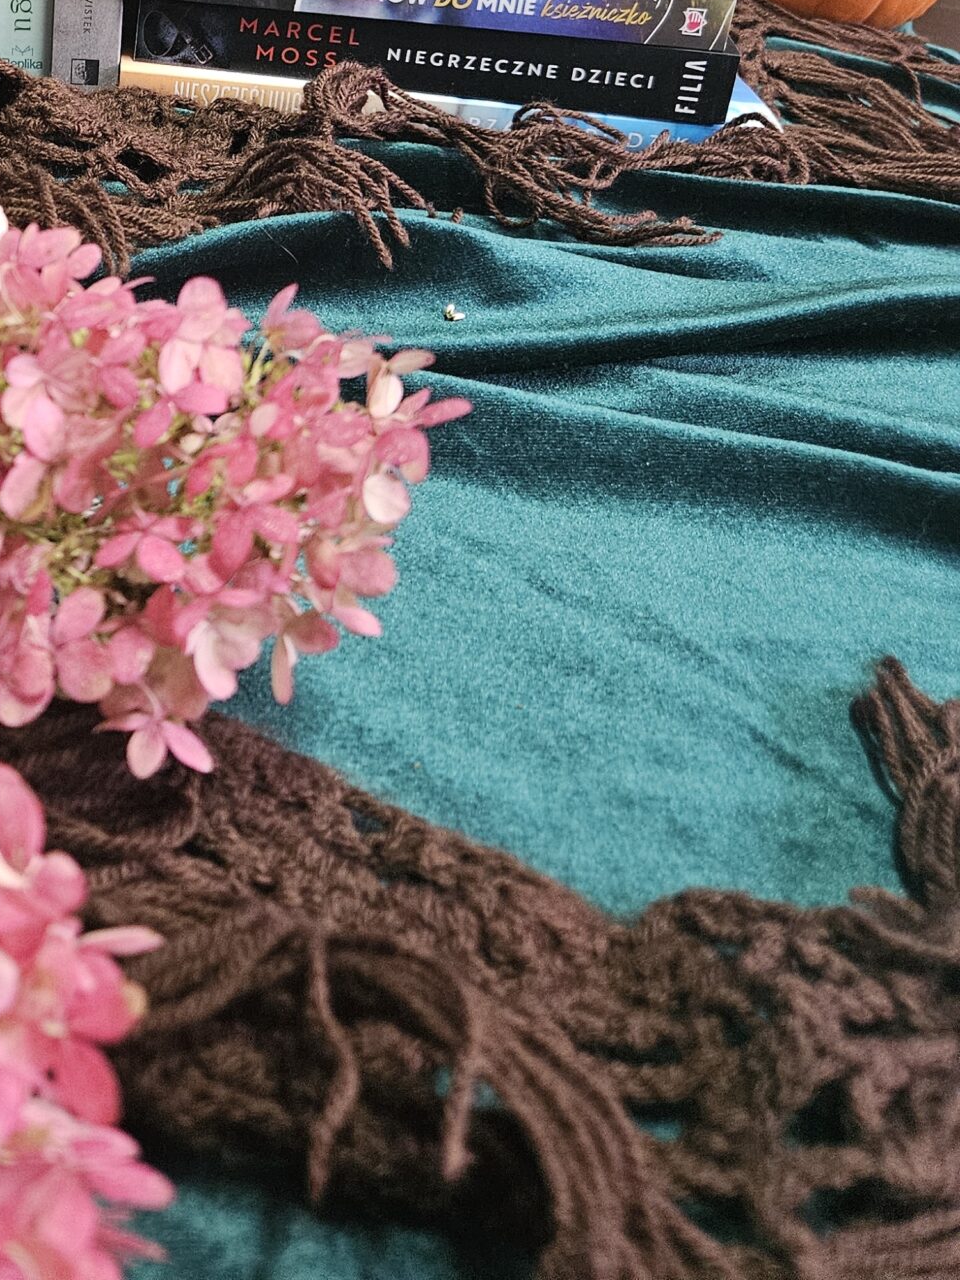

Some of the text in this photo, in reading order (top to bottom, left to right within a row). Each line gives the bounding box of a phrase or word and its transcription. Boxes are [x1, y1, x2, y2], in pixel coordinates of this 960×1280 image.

[239, 16, 360, 47] MARCEL
[3, 58, 43, 70] eplika
[255, 44, 338, 69] MOSS
[386, 47, 656, 90] NIEGRZECZNE DZIECI
[674, 60, 708, 115] FILIA
